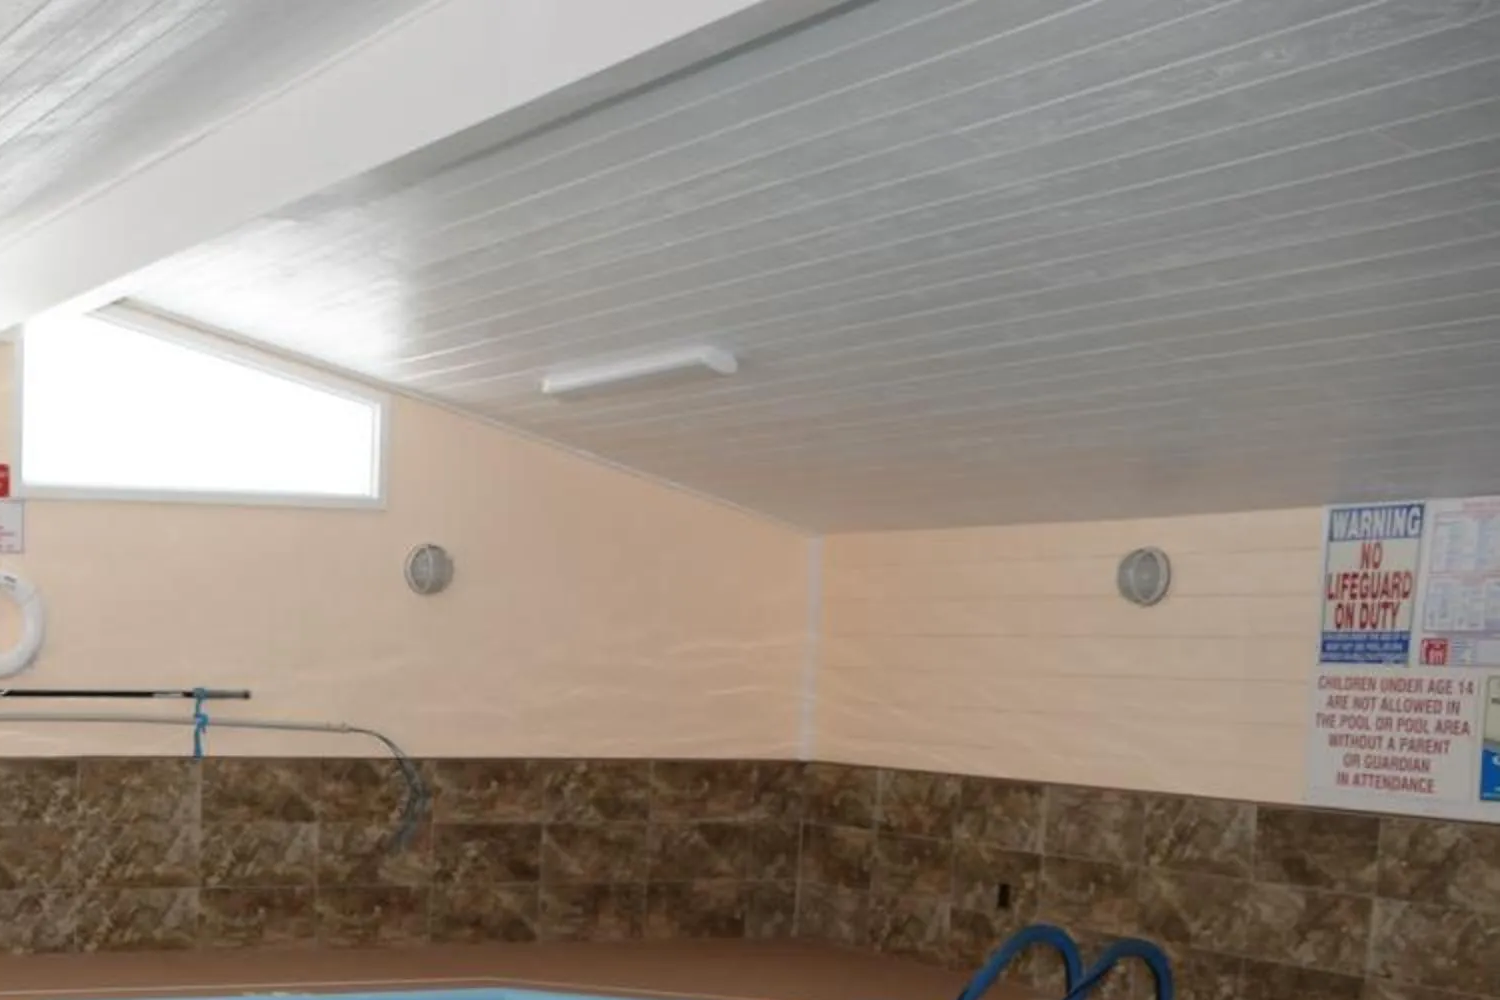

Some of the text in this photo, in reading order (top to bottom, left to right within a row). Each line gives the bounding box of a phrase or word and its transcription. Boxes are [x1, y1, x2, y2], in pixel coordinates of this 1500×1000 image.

[1332, 507, 1421, 539] WARNING
[1360, 542, 1382, 569] NO
[1326, 571, 1412, 600] LIFEGUARD
[1335, 602, 1355, 629] ON
[1360, 601, 1401, 629] DUTY
[1317, 675, 1474, 695] CHILDREN UNDER AGE 14
[1325, 695, 1461, 715] ARE NOT ALLOWED IN
[1316, 713, 1470, 736] THE POOL OR POOL AREA
[1328, 733, 1451, 754] WITHOUT A PARENT
[1342, 753, 1431, 773] OR GUARDIAN
[1336, 771, 1435, 794] IN ATTENDANCE
